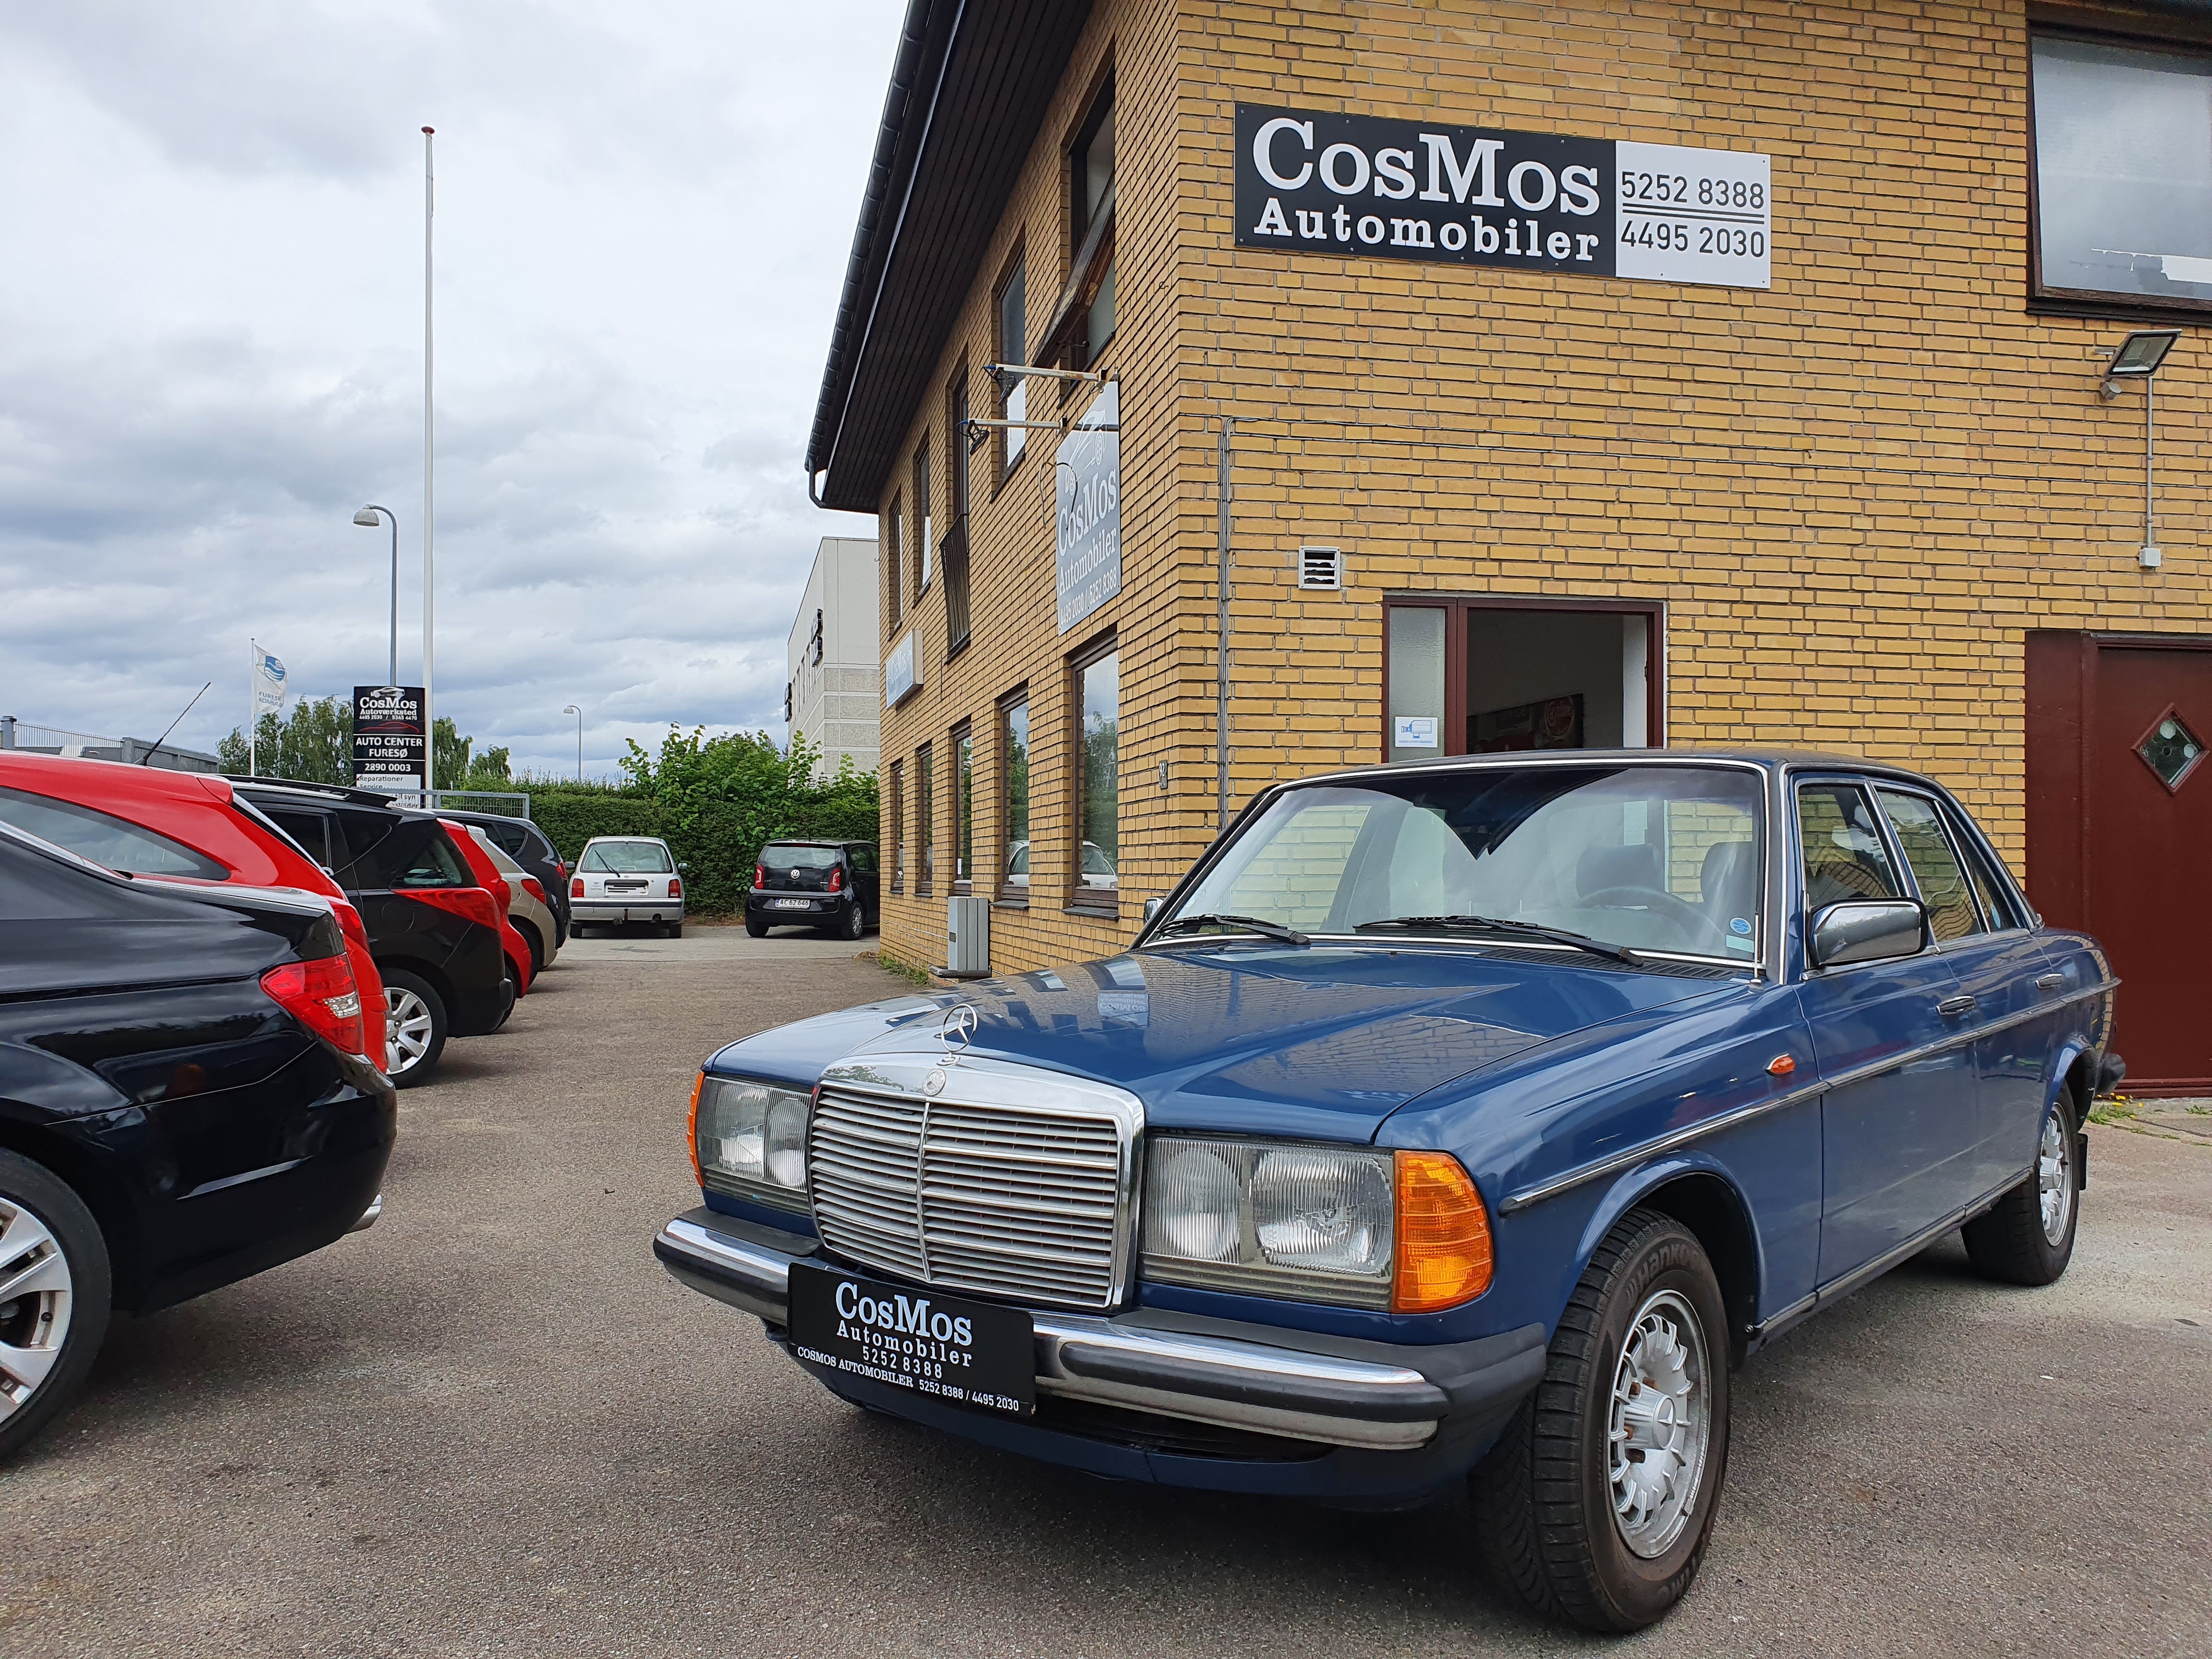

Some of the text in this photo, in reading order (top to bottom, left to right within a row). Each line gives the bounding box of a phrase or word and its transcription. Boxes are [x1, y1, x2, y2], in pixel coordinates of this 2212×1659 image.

[1253, 117, 1600, 216] CosMos
[1621, 171, 1764, 209] 5252 8388
[1254, 197, 1599, 261] Automobiler
[1621, 220, 1764, 258] 4495 2030
[1058, 469, 1116, 557] CosMos
[1059, 527, 1117, 597] Automobiler
[1060, 601, 1071, 627] 4495
[1072, 594, 1085, 619] 2030
[1088, 579, 1102, 606] 5252
[1102, 565, 1118, 597] 8388
[360, 697, 417, 709] CosMos
[356, 737, 423, 747] AUTO CENTER
[369, 748, 408, 758] FURESØ
[364, 763, 411, 772] 2890 0003
[1159, 763, 1165, 777] 92
[836, 1282, 973, 1346] CosMos
[836, 1319, 972, 1367] Automobiler
[862, 1346, 943, 1379] 5252 8388
[797, 1346, 837, 1367] COSMOS
[838, 1358, 914, 1388] AUTOMOBILER
[919, 1379, 940, 1395] 5252
[942, 1384, 964, 1400] 8388
[972, 1391, 995, 1407] 4495
[996, 1396, 1019, 1412] 2030
